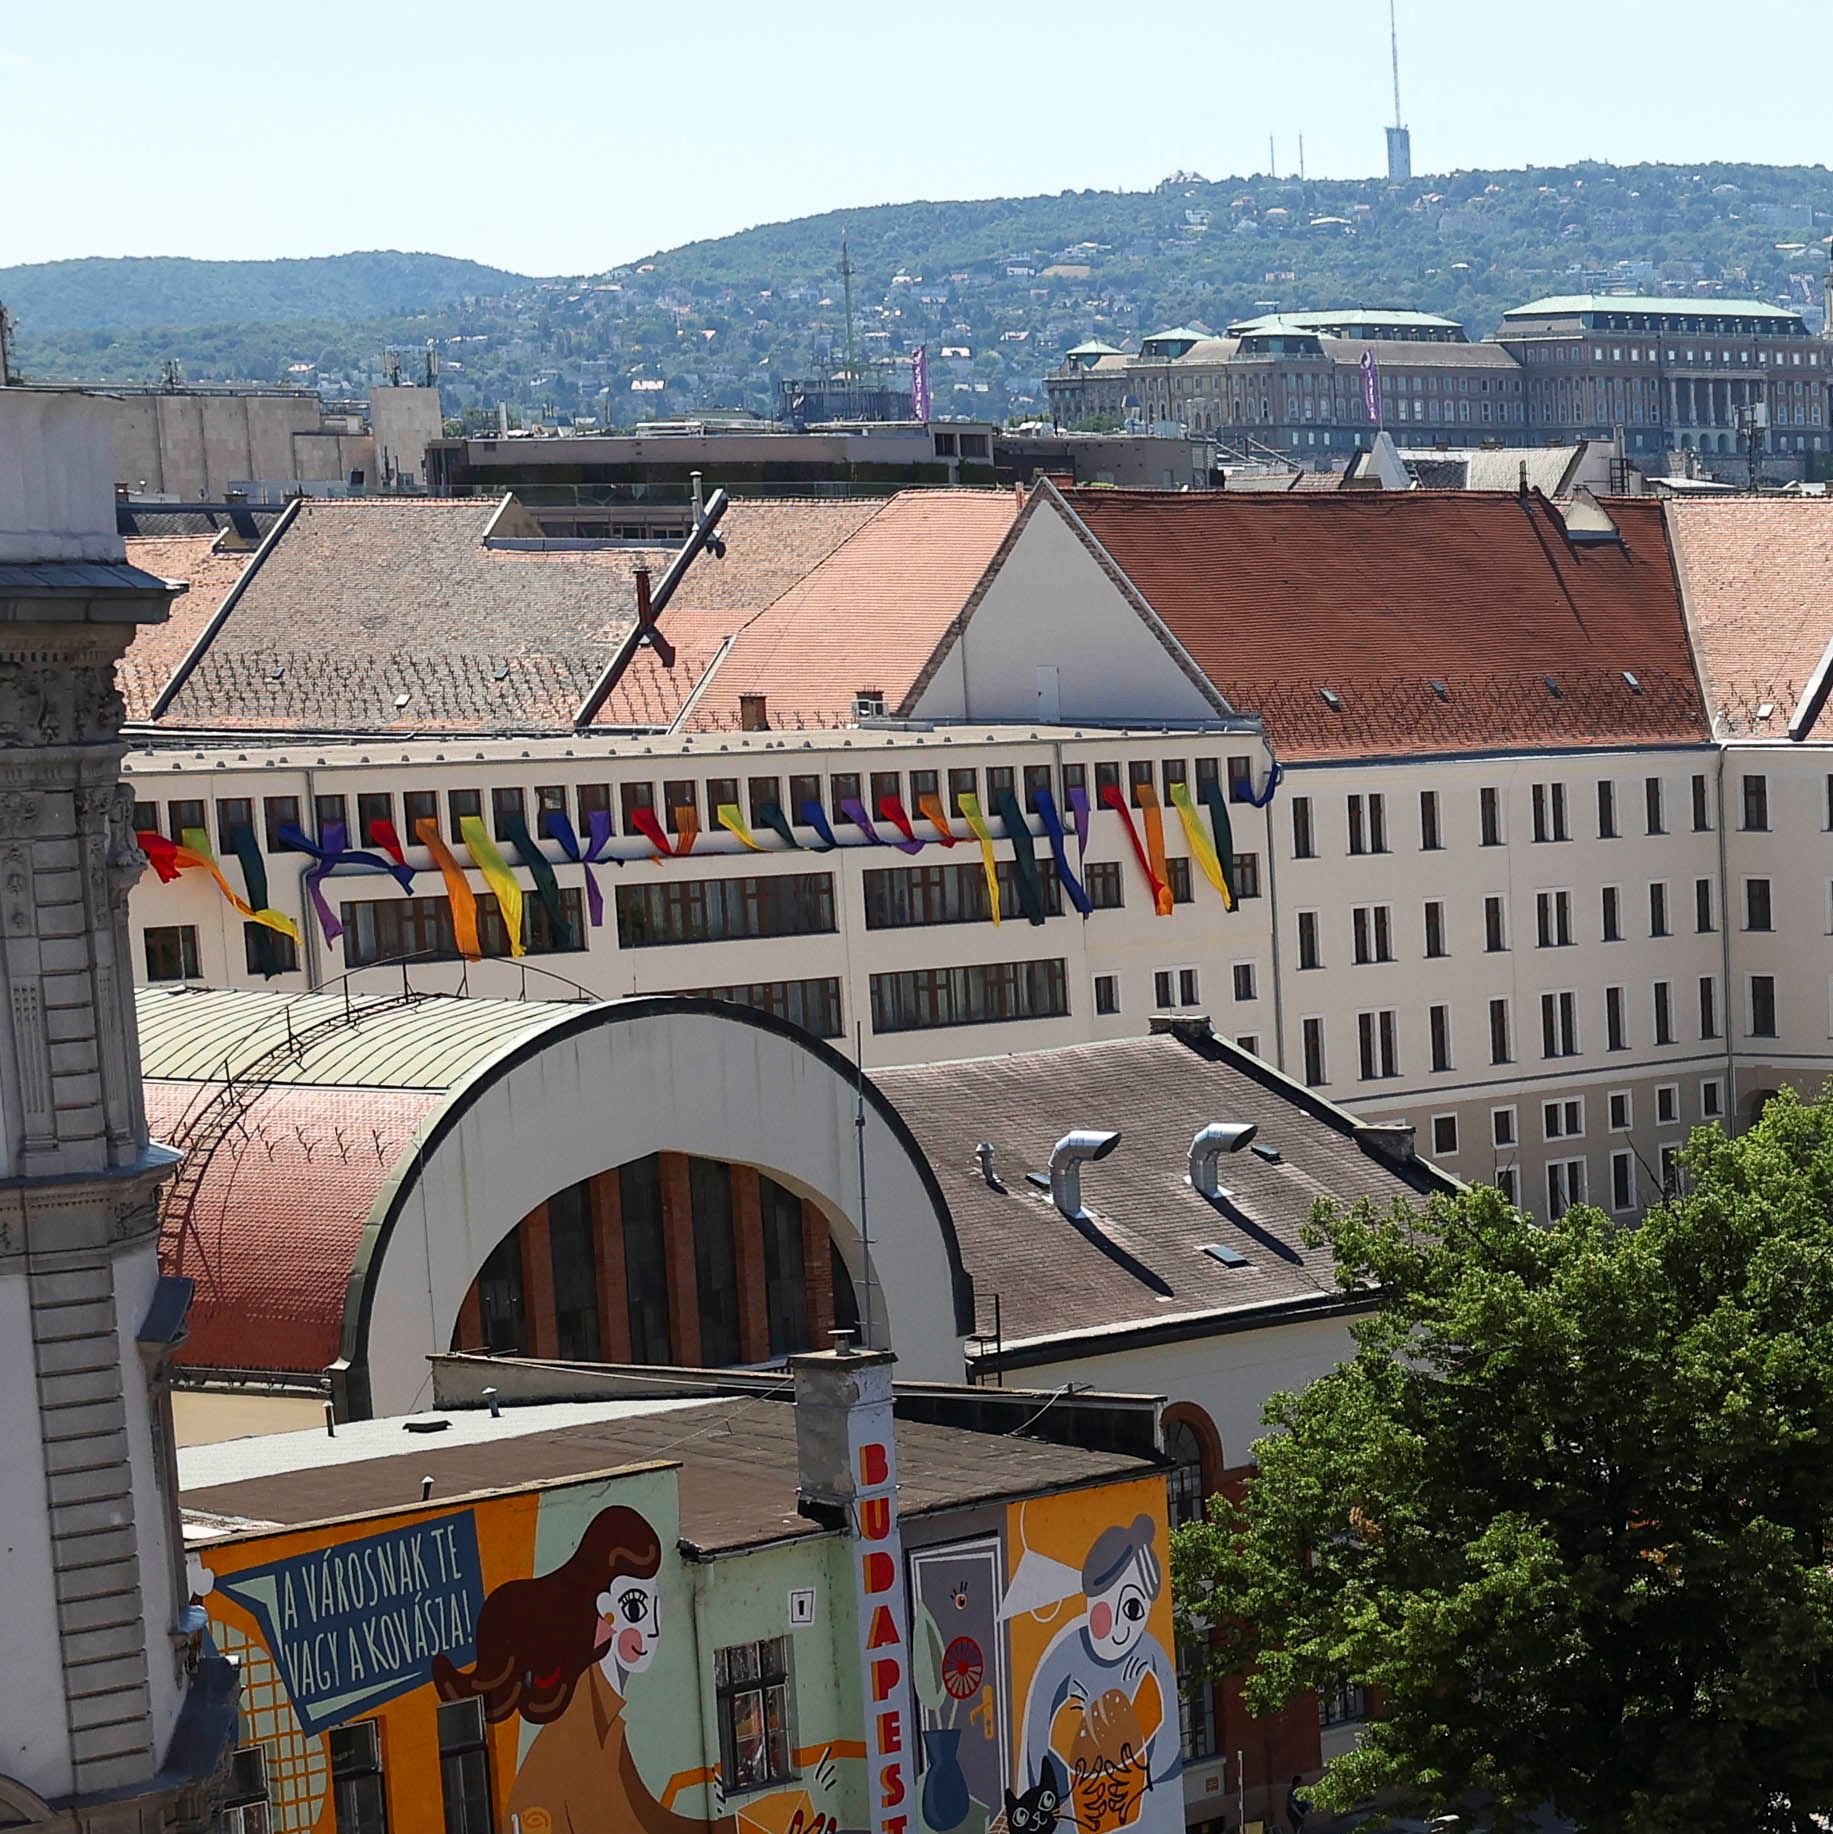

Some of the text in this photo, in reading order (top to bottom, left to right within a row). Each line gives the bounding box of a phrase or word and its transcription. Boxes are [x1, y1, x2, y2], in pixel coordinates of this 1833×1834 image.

[285, 1525, 462, 1630] A VÁROSNAK TE
[285, 1589, 473, 1698] VAGY A KOVÁSZA!
